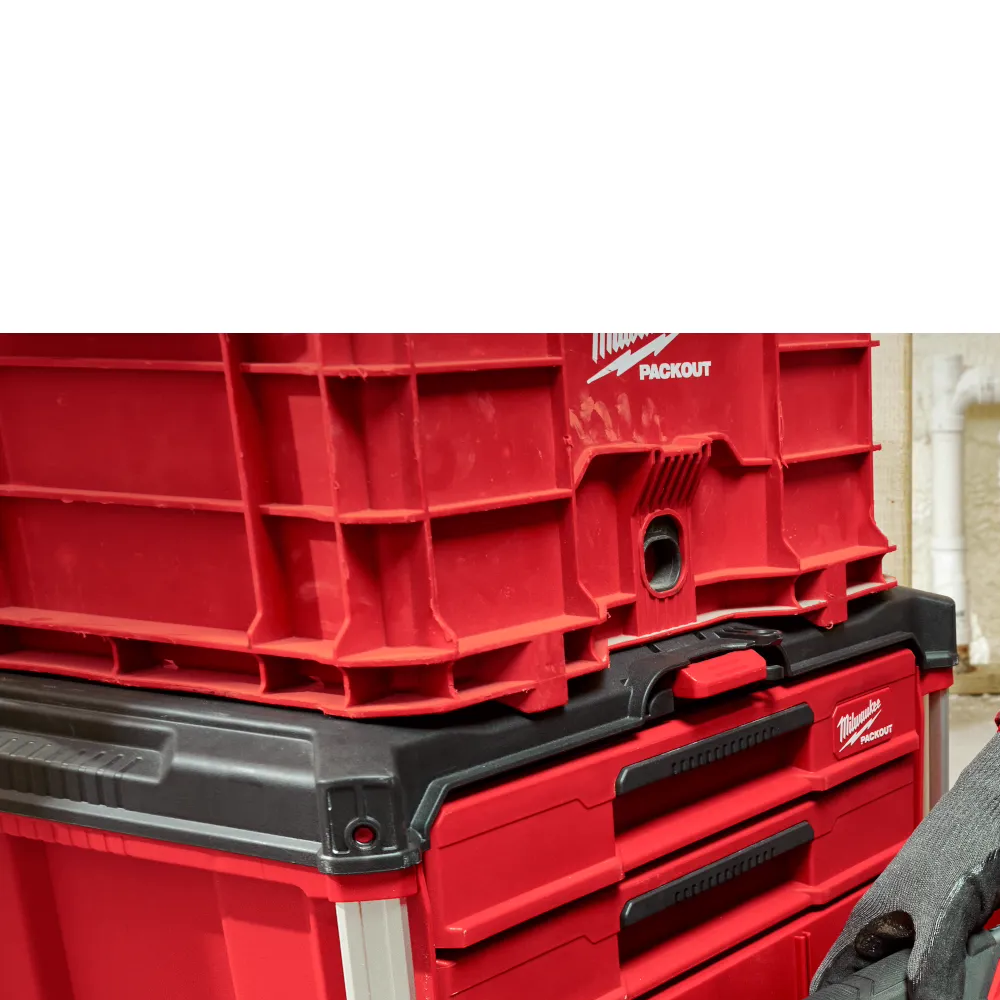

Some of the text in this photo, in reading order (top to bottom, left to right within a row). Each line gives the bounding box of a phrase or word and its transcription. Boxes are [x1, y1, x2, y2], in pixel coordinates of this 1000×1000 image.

[639, 361, 712, 380] PACKOUT
[837, 698, 882, 743] Milwaukee
[860, 724, 893, 745] PACKOUT
